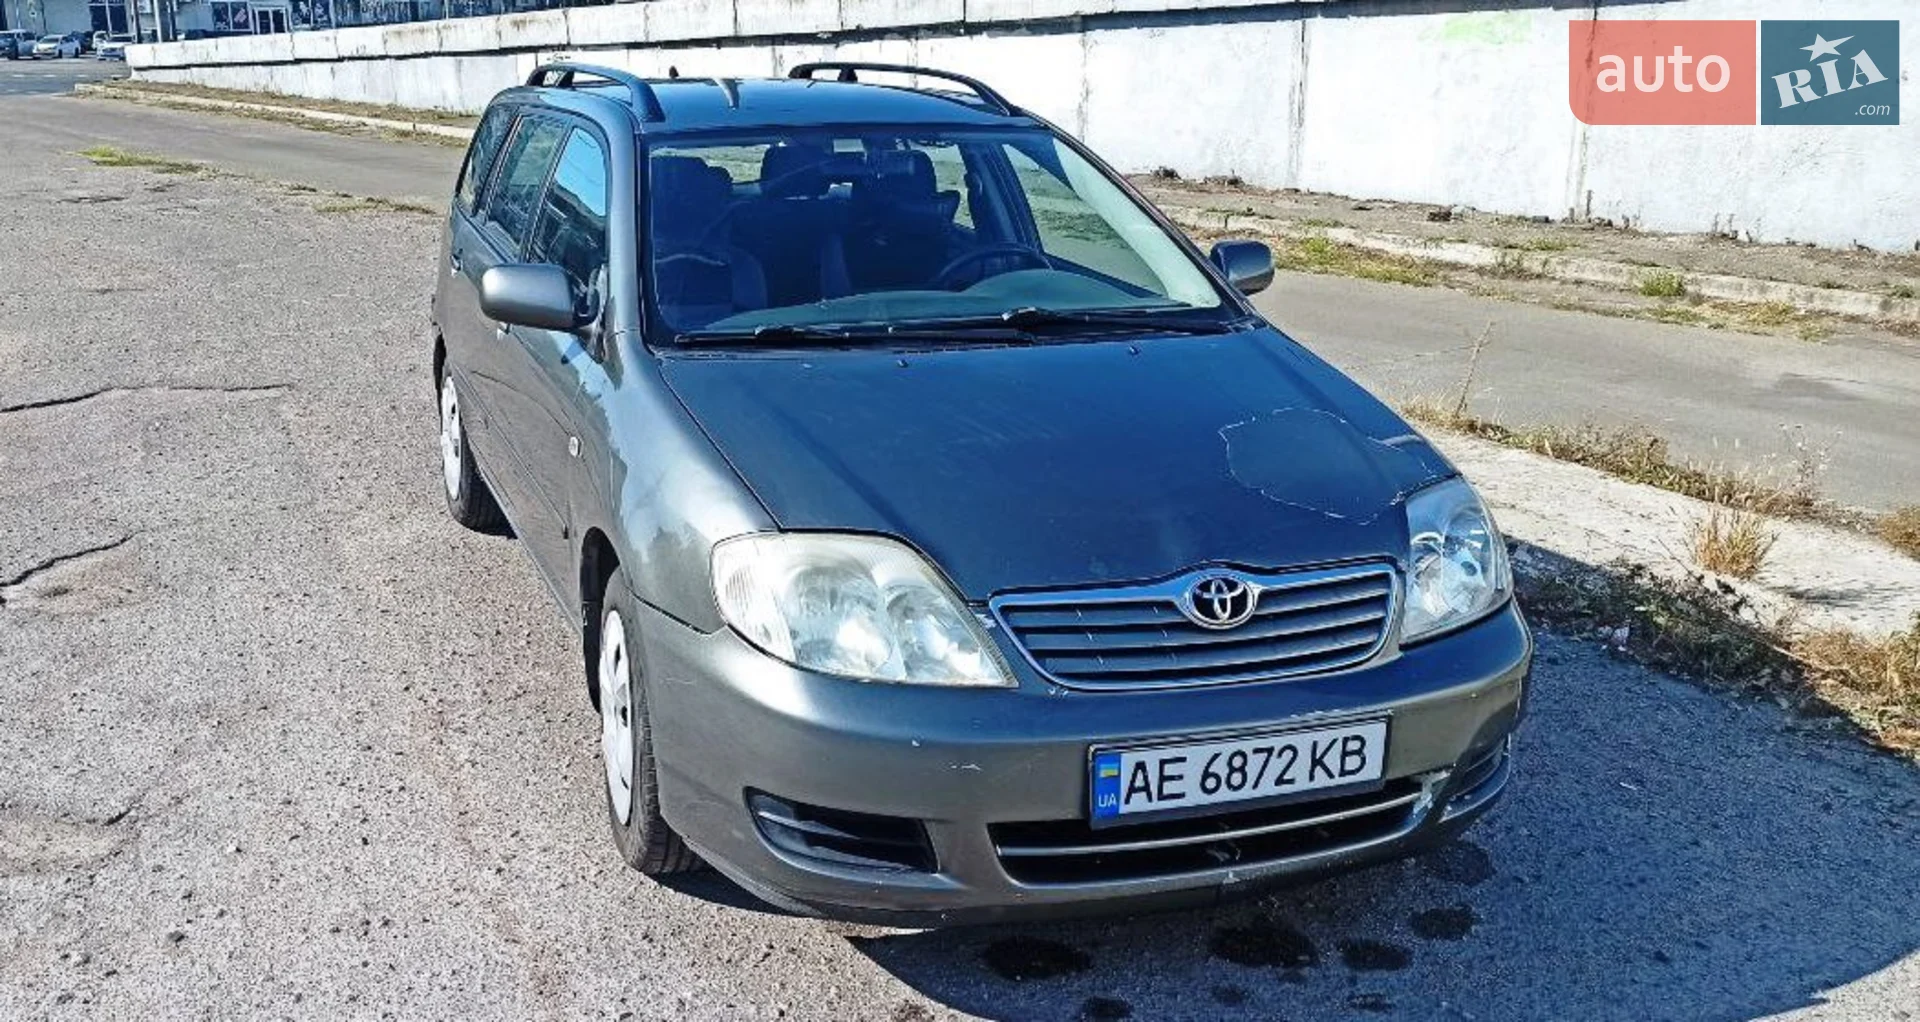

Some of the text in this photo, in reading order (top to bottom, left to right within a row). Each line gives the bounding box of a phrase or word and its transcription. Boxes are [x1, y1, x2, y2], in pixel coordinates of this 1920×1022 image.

[1124, 734, 1367, 804] AE 6872 KB
[1098, 791, 1118, 808] UA
